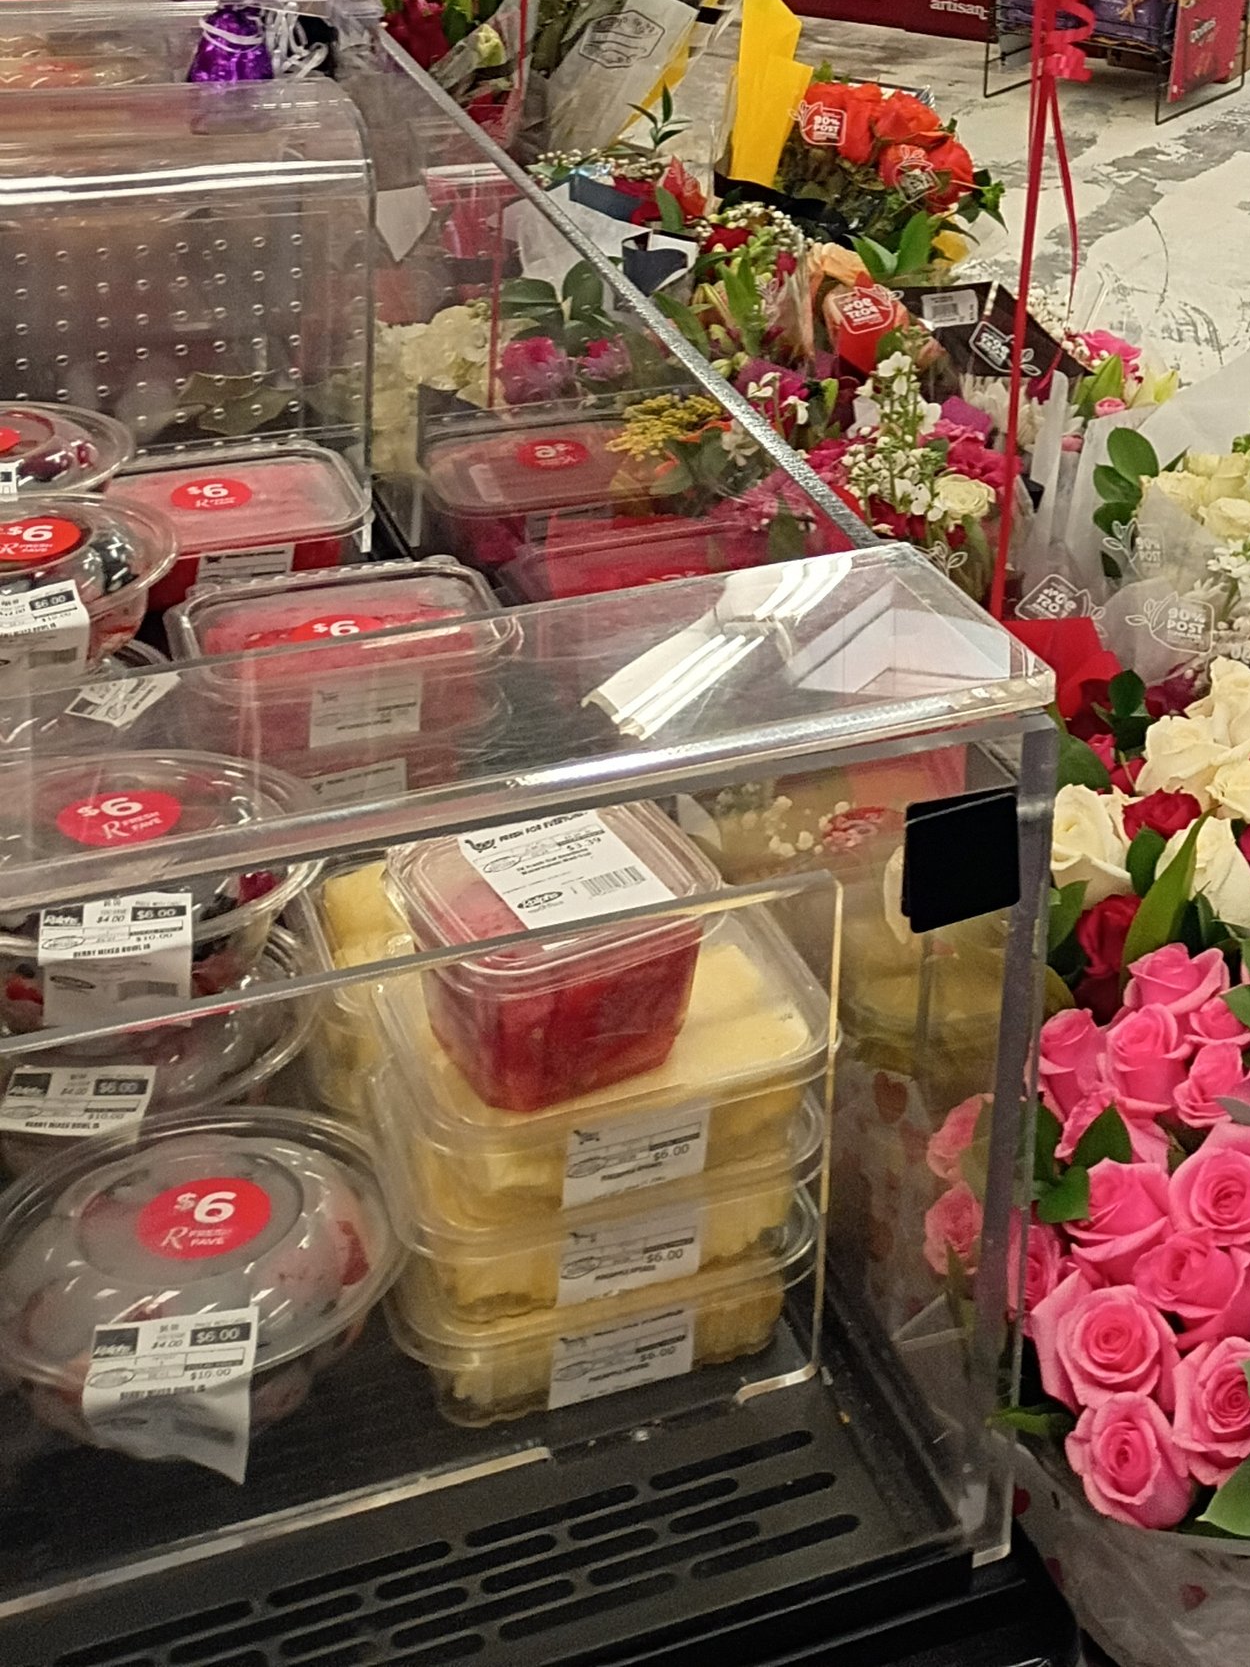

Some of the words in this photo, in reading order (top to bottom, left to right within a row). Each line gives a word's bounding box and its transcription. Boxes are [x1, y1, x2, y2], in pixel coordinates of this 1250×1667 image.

[187, 483, 229, 498] $6
[7, 524, 54, 542] $6
[34, 595, 66, 609] $6.00
[312, 619, 359, 636] $6
[1166, 618, 1206, 634] POST
[76, 797, 144, 817] $6
[566, 837, 602, 851] $3.39
[96, 916, 125, 924] $4.00
[136, 908, 177, 920] $6.00
[136, 932, 173, 942] $10.00
[653, 1144, 690, 1162] $6.00
[174, 1191, 236, 1224] $6
[646, 1248, 683, 1264] $6.00
[152, 1339, 183, 1349] $4.00
[196, 1327, 240, 1343] $6.00
[640, 1344, 676, 1362] $6.00
[190, 1368, 232, 1381] $10.00
